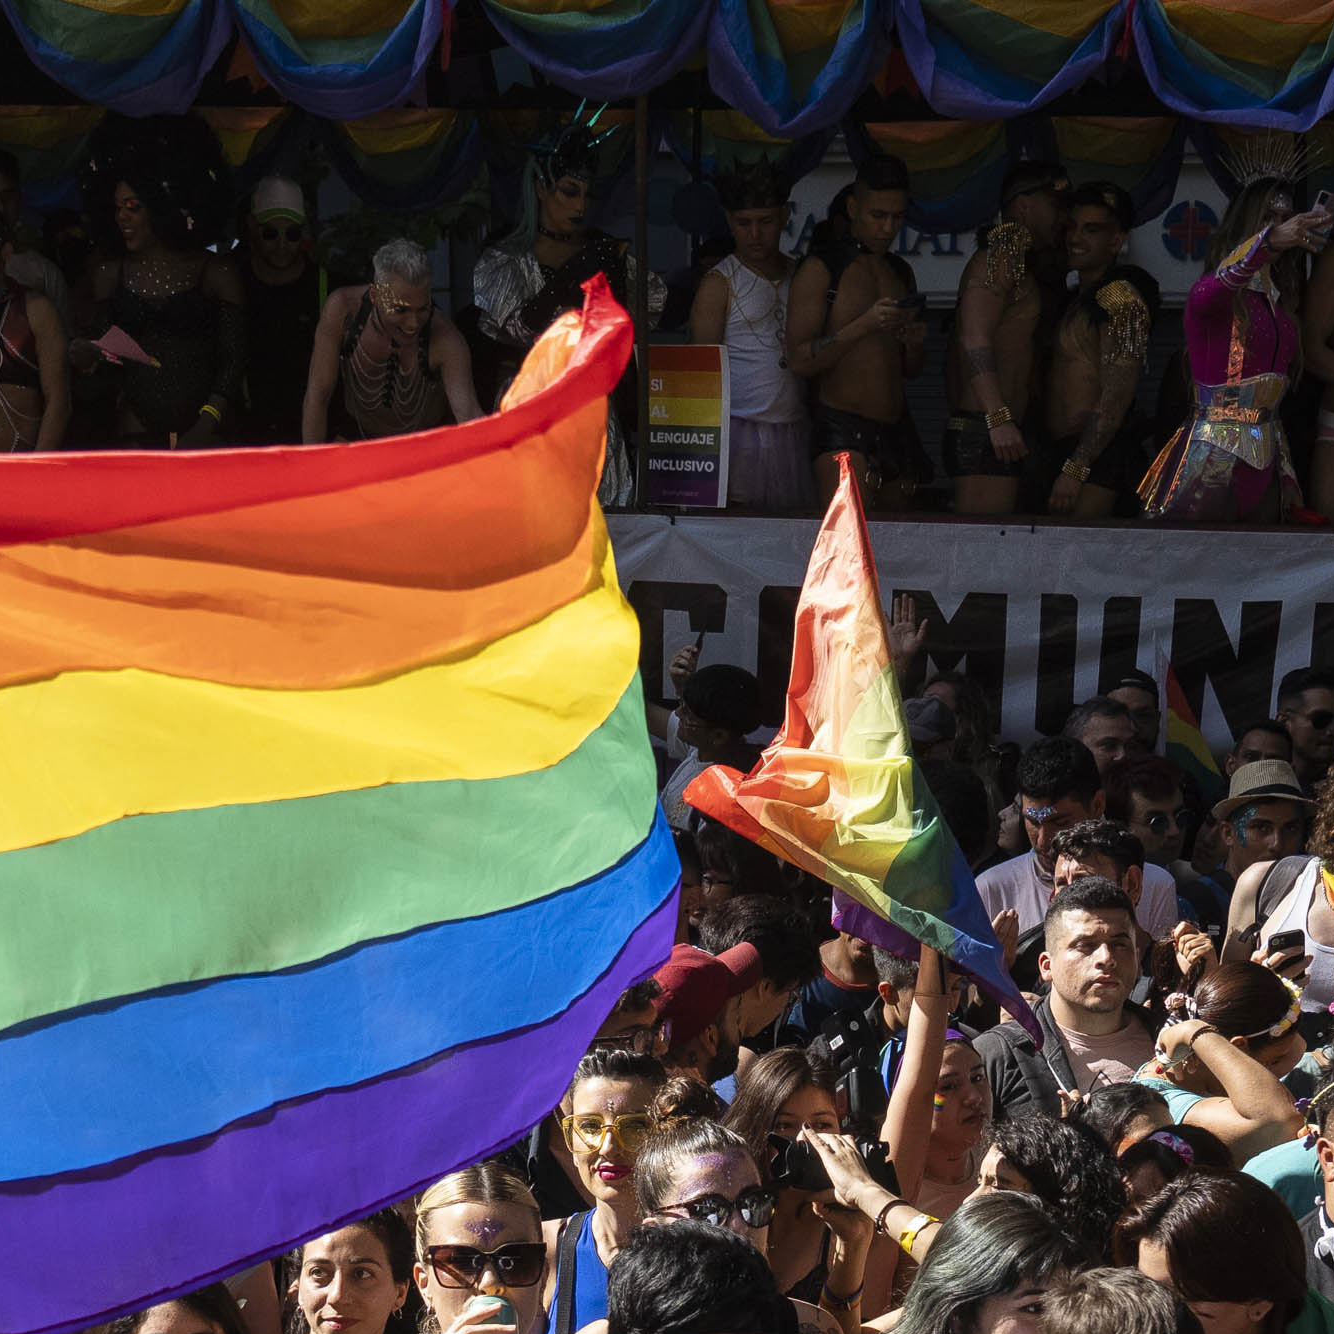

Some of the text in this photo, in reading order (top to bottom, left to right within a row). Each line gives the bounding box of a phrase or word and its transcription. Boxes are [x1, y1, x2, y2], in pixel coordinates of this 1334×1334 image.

[651, 405, 668, 418] AL
[649, 431, 715, 445] LENGUAJE
[648, 458, 715, 473] INCLUSIVO
